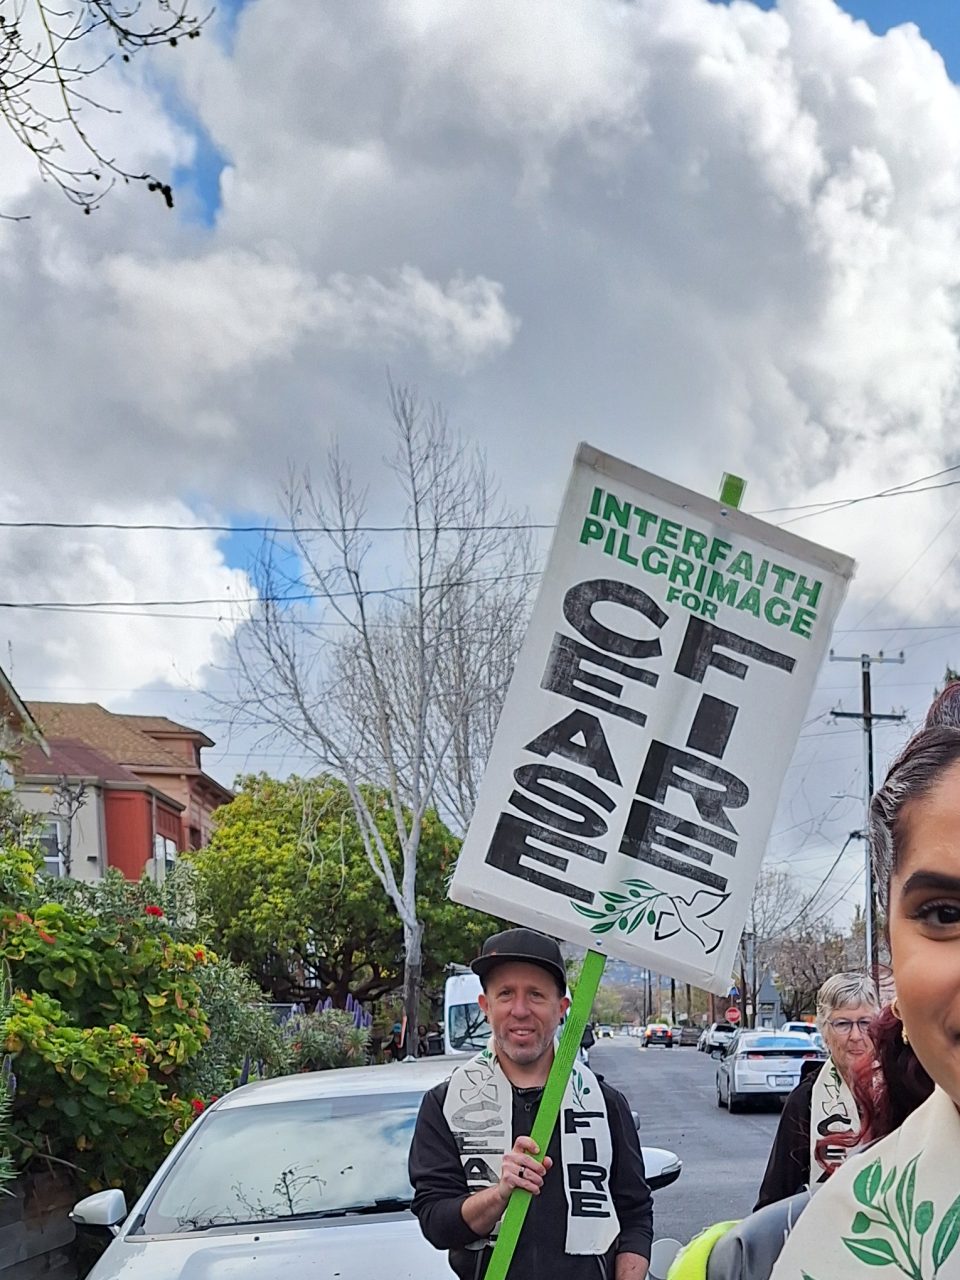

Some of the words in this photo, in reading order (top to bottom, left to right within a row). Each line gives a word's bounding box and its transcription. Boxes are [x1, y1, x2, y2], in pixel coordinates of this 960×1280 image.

[579, 516, 818, 640] PILGRIMAGE
[588, 486, 823, 609] INTERFAITH
[665, 585, 719, 621] FOR
[484, 578, 670, 905] CEASE
[617, 614, 797, 892] FIRE
[563, 1108, 611, 1218] FIRE
